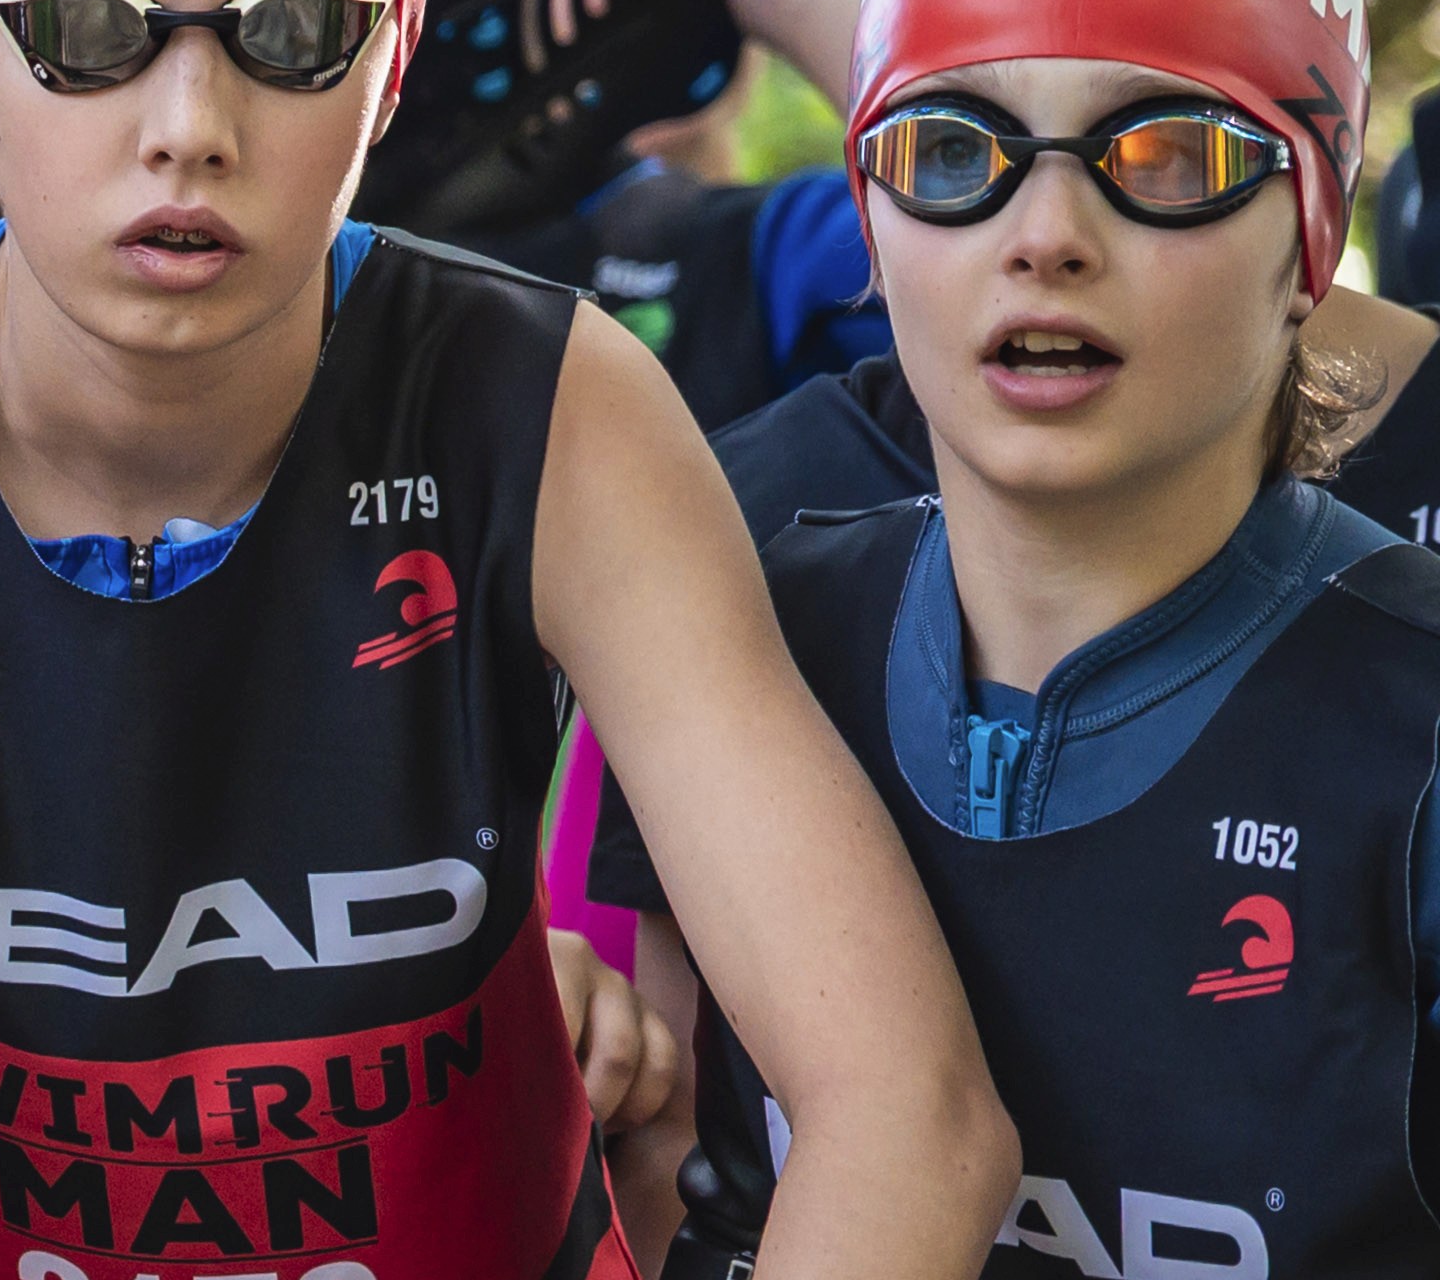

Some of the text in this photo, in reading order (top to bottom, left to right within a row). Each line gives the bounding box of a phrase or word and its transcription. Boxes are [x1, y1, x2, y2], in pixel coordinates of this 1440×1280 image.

[313, 60, 347, 82] arena
[349, 474, 440, 527] 2179
[1211, 816, 1300, 871] 1052
